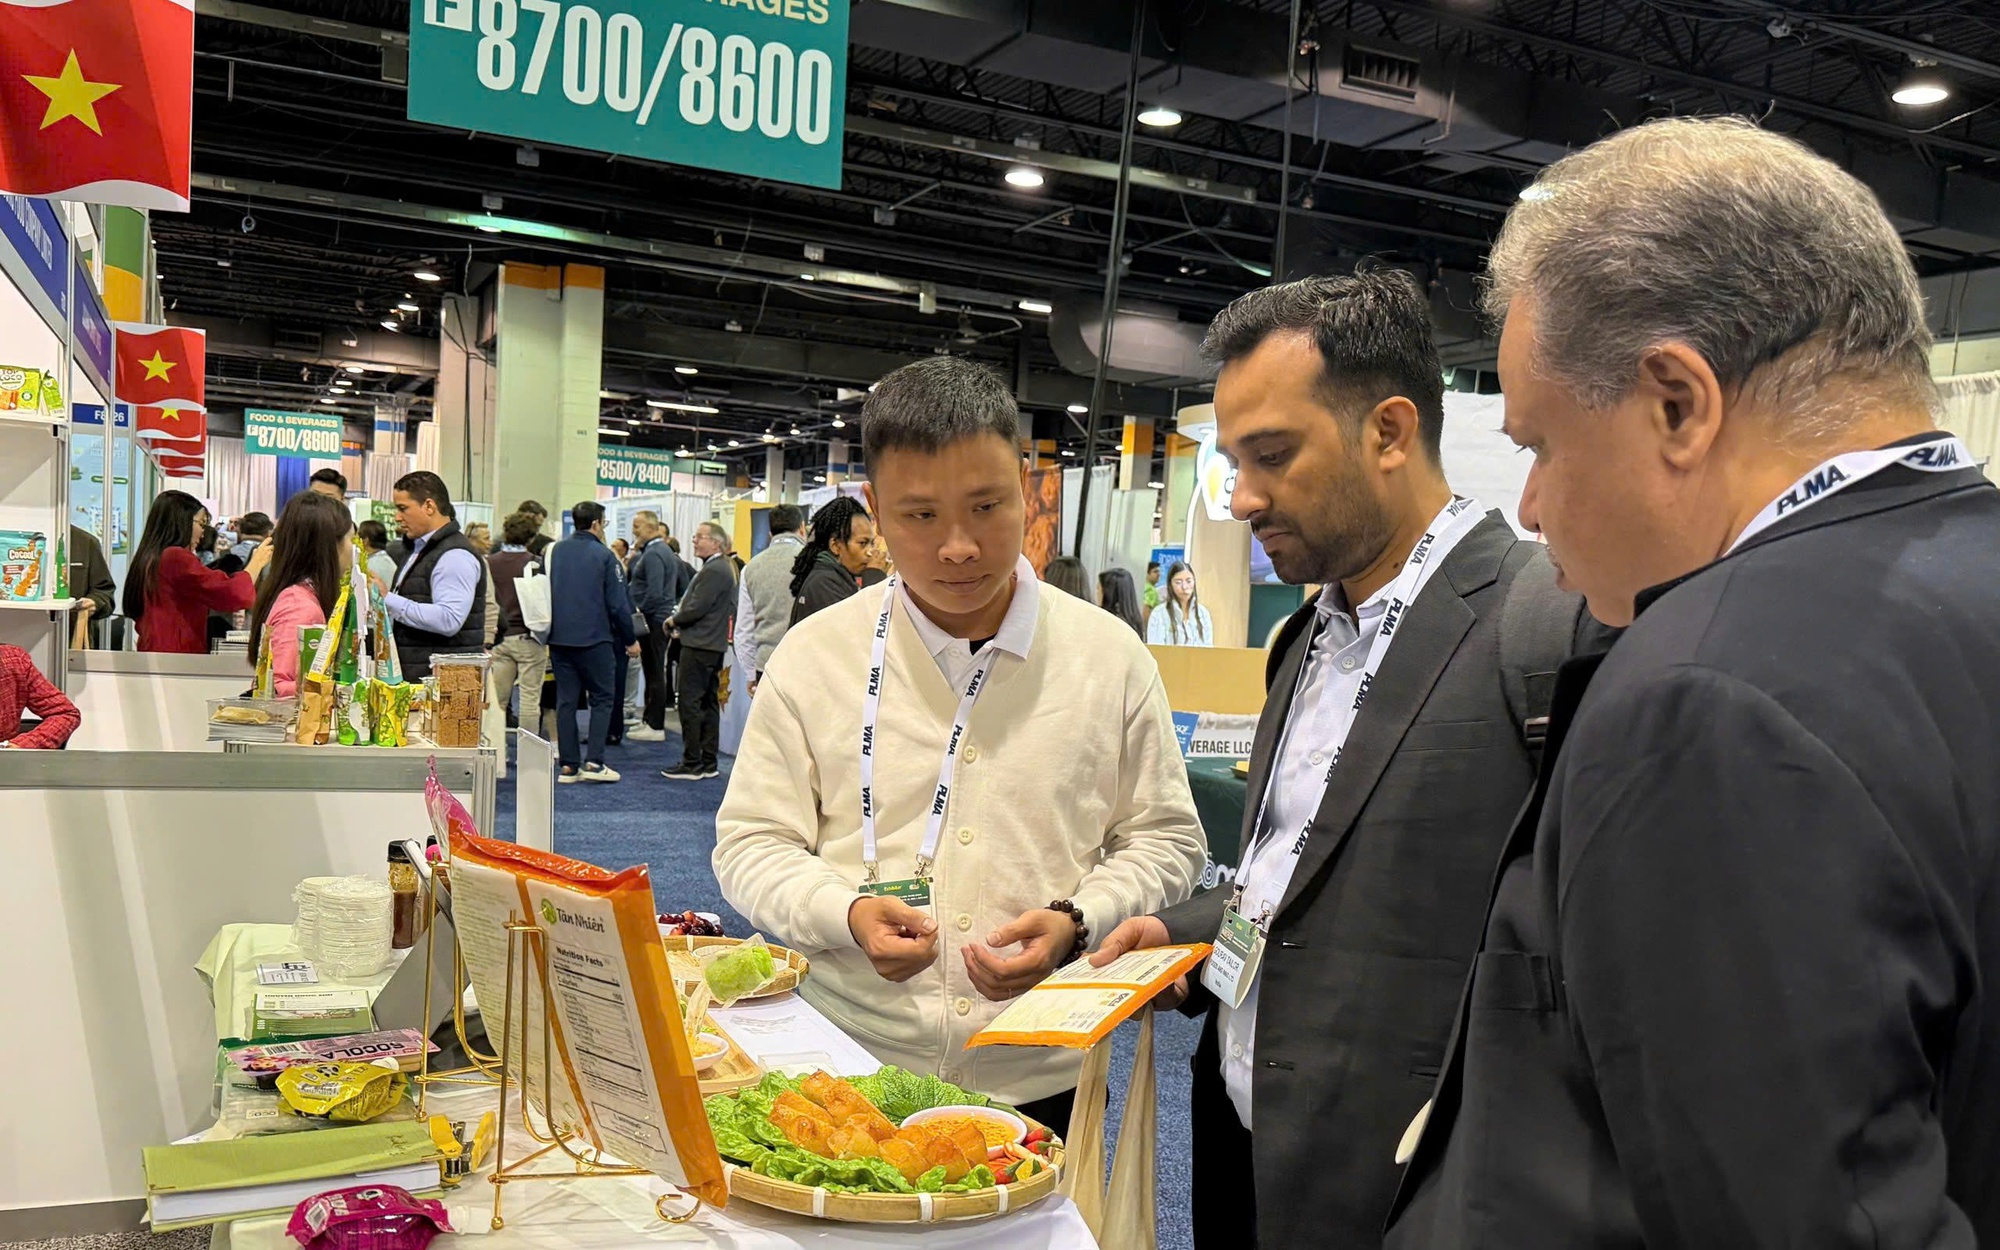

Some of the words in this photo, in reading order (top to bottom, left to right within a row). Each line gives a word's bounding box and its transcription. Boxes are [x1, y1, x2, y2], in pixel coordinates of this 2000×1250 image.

[477, 0, 832, 145] 8700/8600
[94, 410, 125, 422] F826
[250, 413, 275, 422] FOOD
[285, 416, 338, 428] BEVERAGES
[599, 448, 615, 456] OOD
[625, 450, 669, 461] BEVERAGES
[600, 459, 670, 485] 8500/8400
[556, 946, 585, 962] Nutrition
[585, 955, 604, 967] Facts
